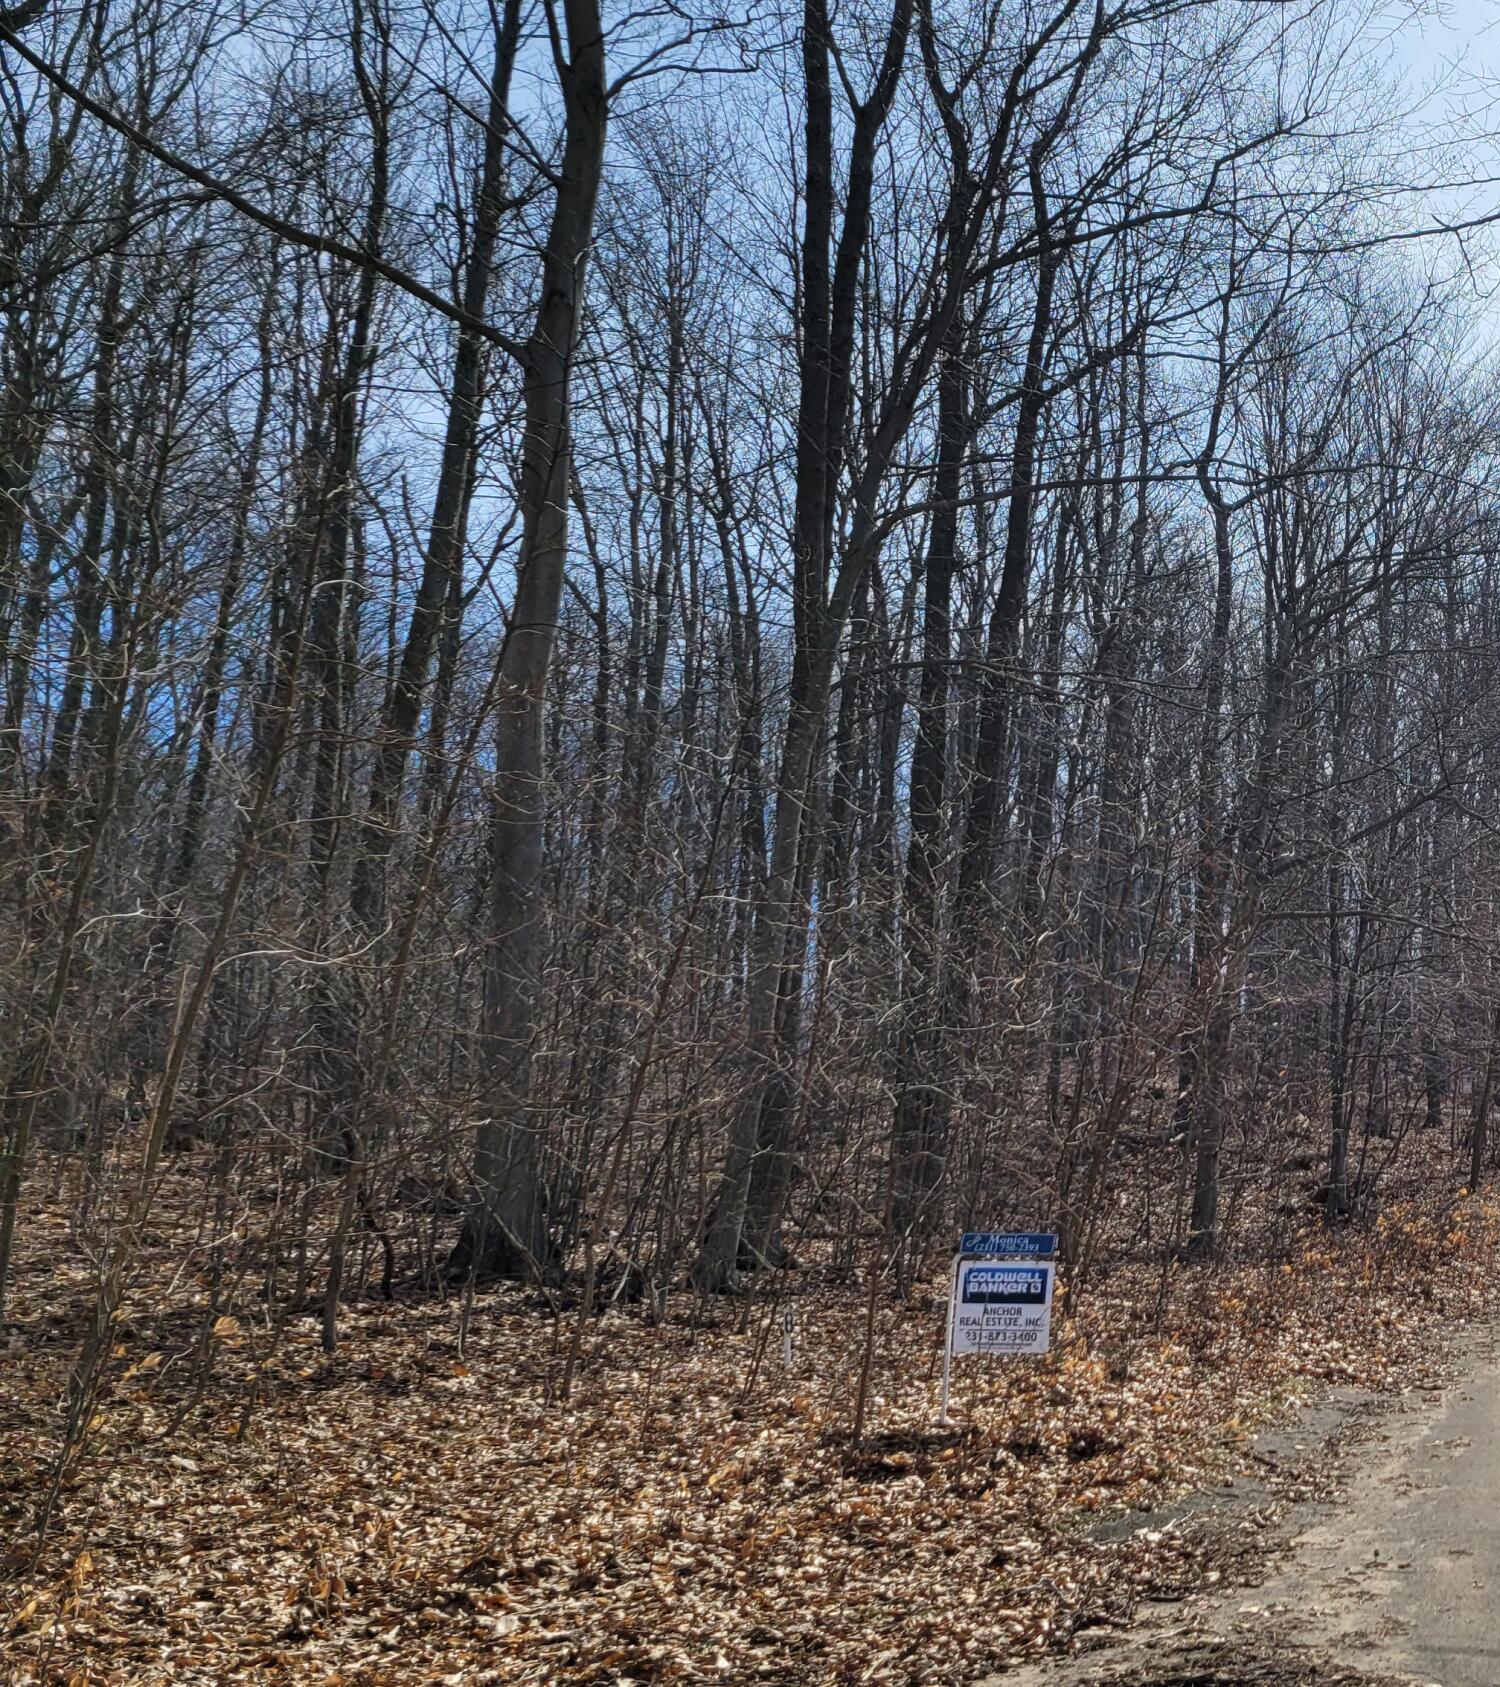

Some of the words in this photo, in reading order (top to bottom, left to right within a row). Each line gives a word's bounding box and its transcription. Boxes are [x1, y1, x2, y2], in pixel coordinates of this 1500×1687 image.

[987, 1234, 1029, 1244] Monica
[969, 1271, 1043, 1282] COLDWELL
[968, 1282, 1028, 1293] BANKER
[983, 1306, 1023, 1316] ANCHOR
[959, 1317, 982, 1326] REAL
